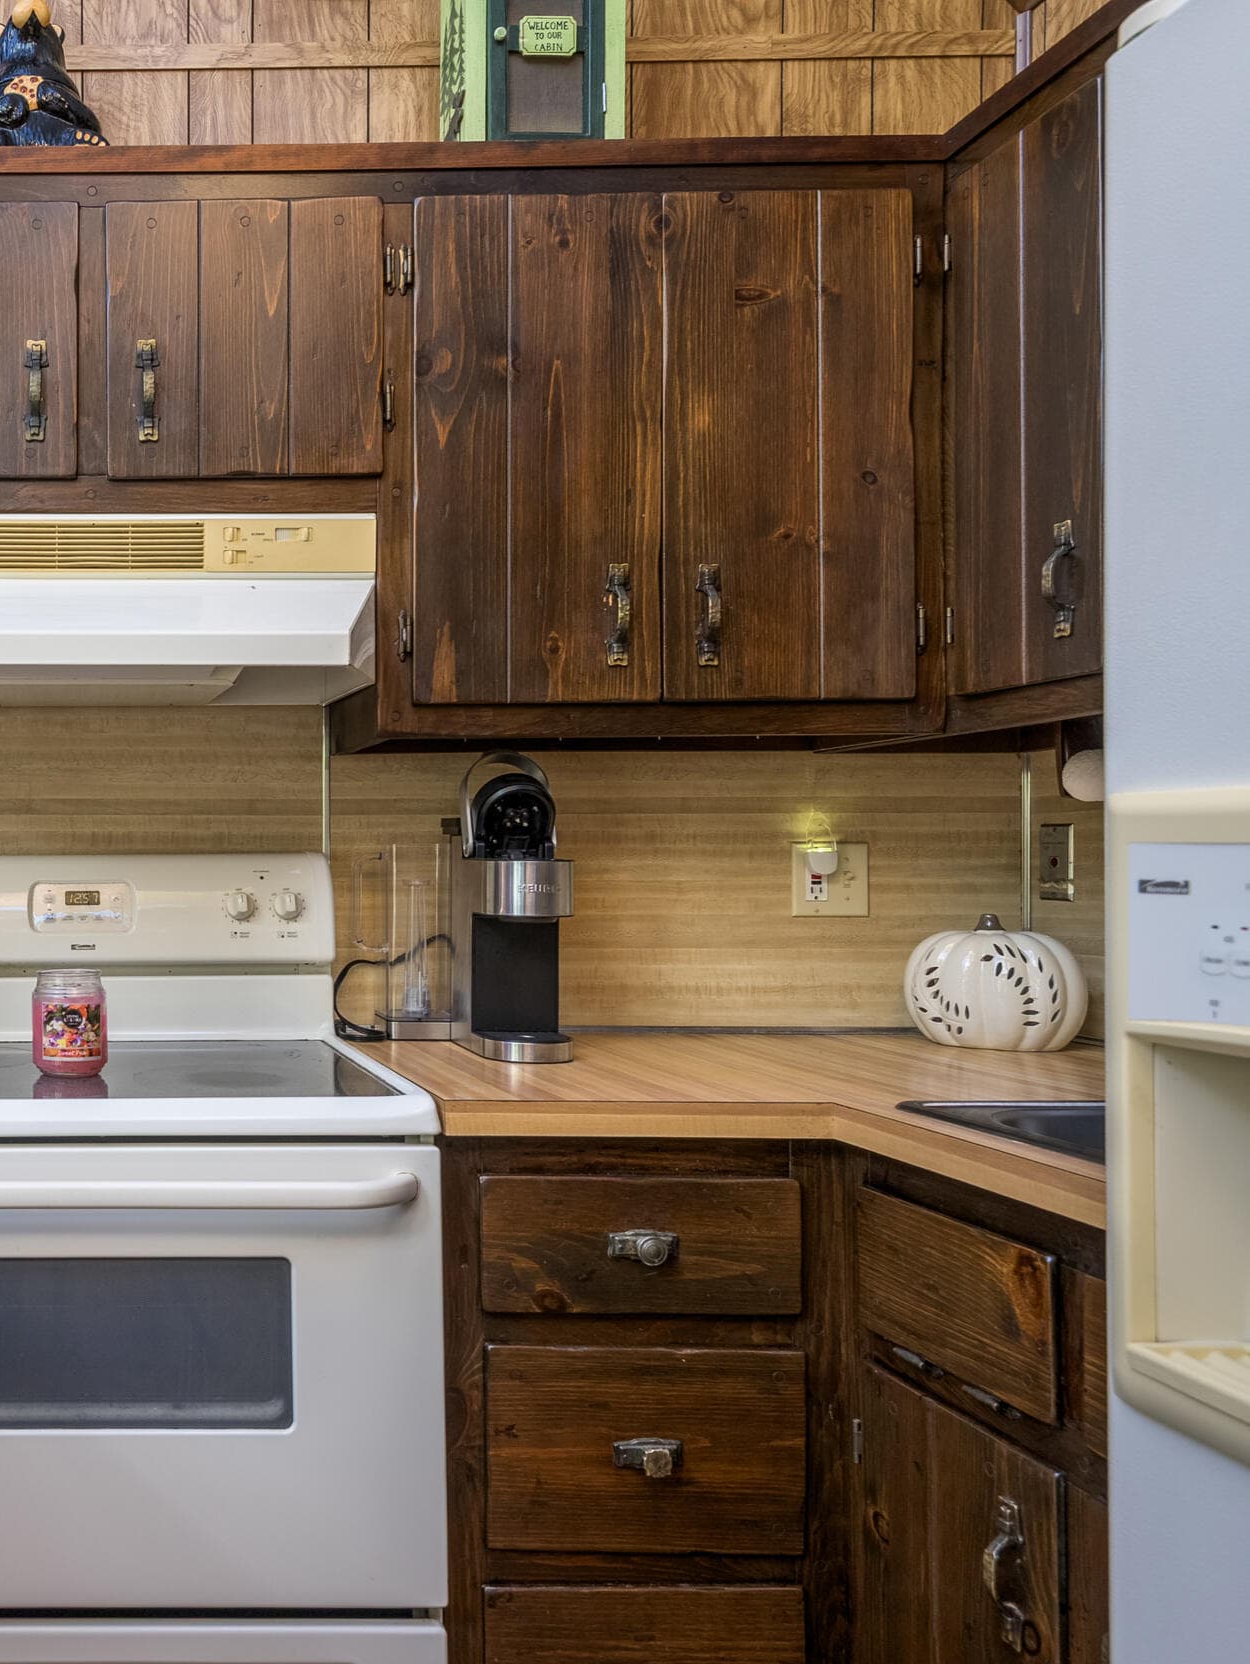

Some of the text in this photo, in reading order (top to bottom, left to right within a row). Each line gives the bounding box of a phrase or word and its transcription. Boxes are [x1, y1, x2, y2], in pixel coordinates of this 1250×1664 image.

[527, 21, 569, 31] WELCOME
[534, 31, 562, 40] TO OUR
[534, 43, 563, 52] CABIN
